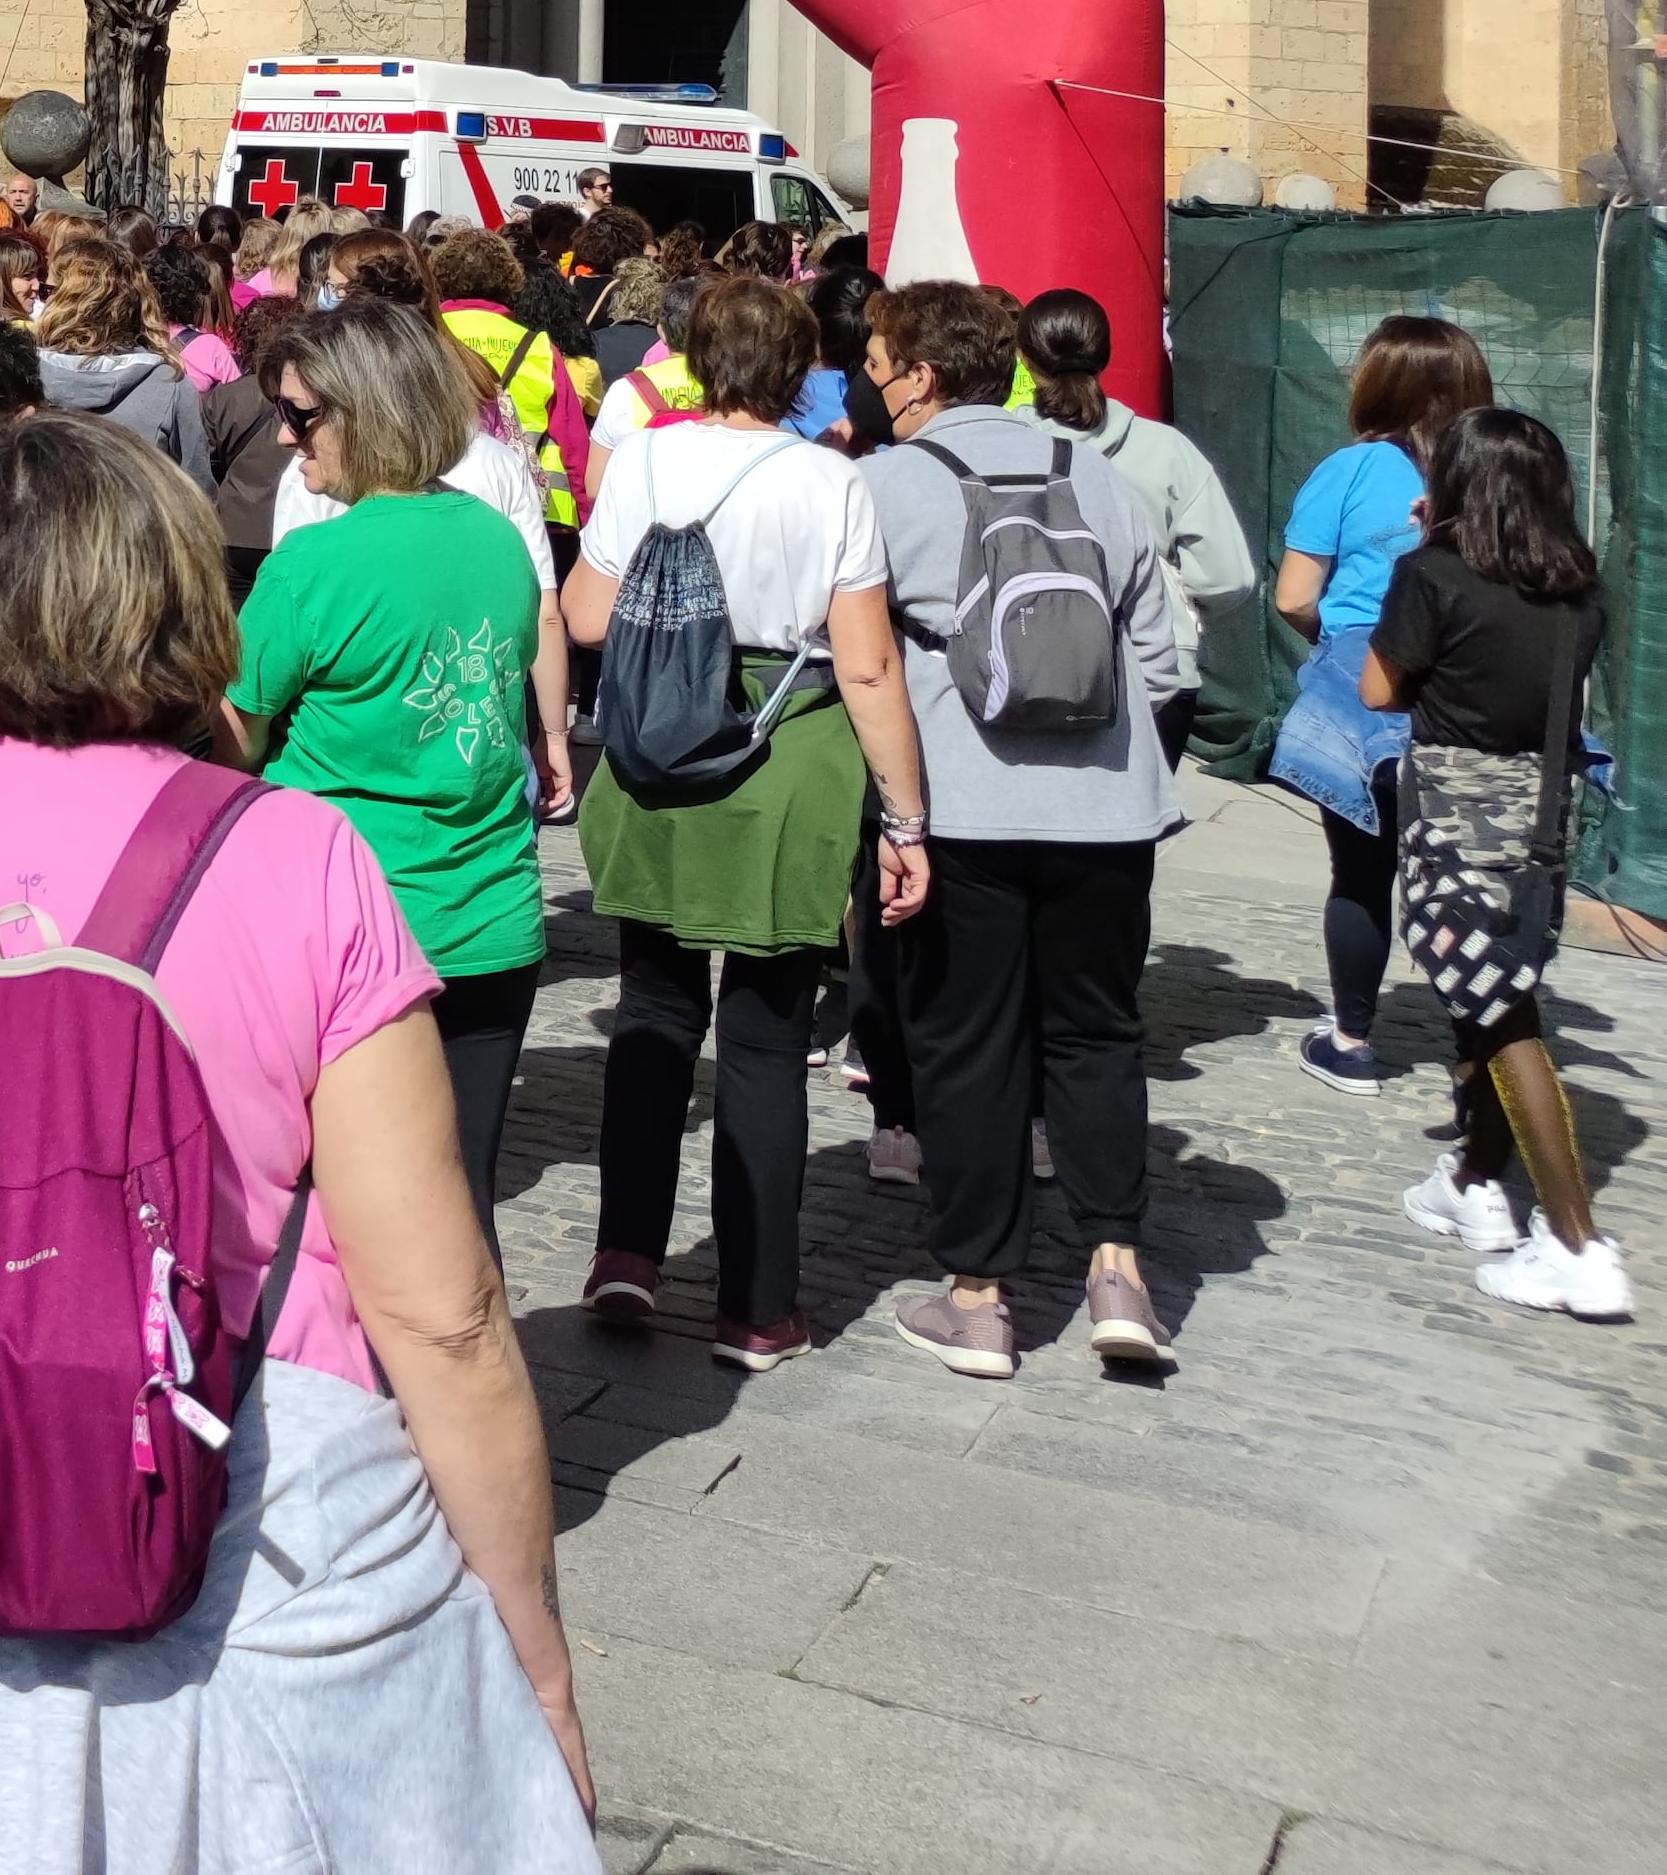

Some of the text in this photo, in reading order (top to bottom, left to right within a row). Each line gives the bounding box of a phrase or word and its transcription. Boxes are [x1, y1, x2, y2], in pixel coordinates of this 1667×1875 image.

[262, 113, 387, 133] AMBULANCIA
[487, 117, 532, 137] S.V.B
[644, 127, 750, 152] AMBULANCIA
[514, 167, 540, 191] 900
[544, 169, 561, 193] 22
[457, 654, 488, 683] 18
[5, 1246, 59, 1273] QUECHUA
